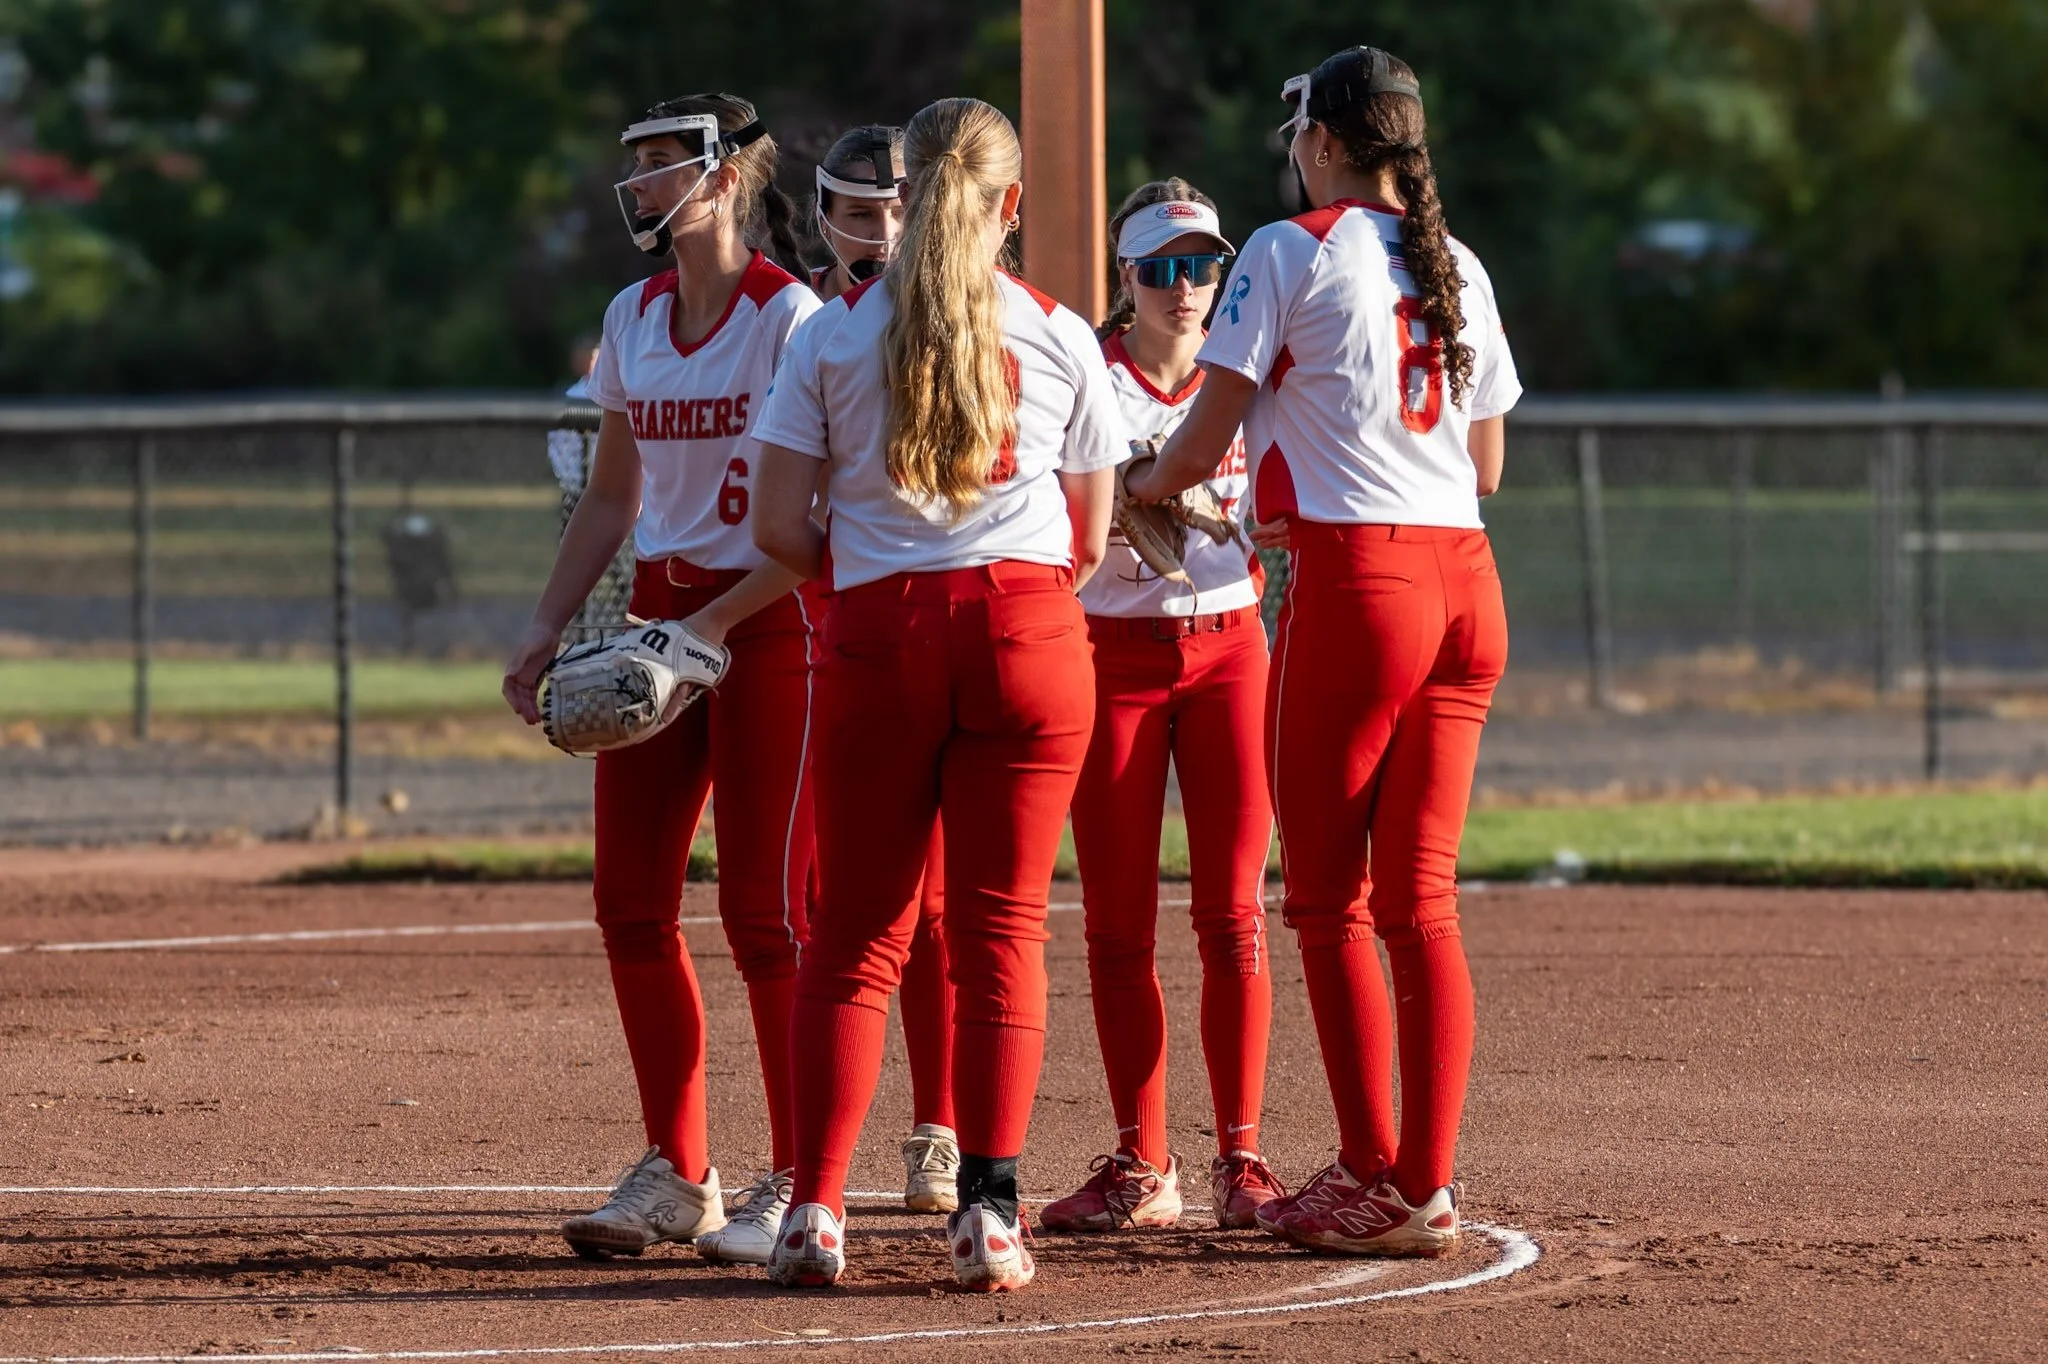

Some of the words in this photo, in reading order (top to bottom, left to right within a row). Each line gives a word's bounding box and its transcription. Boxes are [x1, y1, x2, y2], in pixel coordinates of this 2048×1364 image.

[626, 392, 751, 441] HARMERS
[718, 457, 749, 526] 6
[685, 646, 722, 676] Wilson
